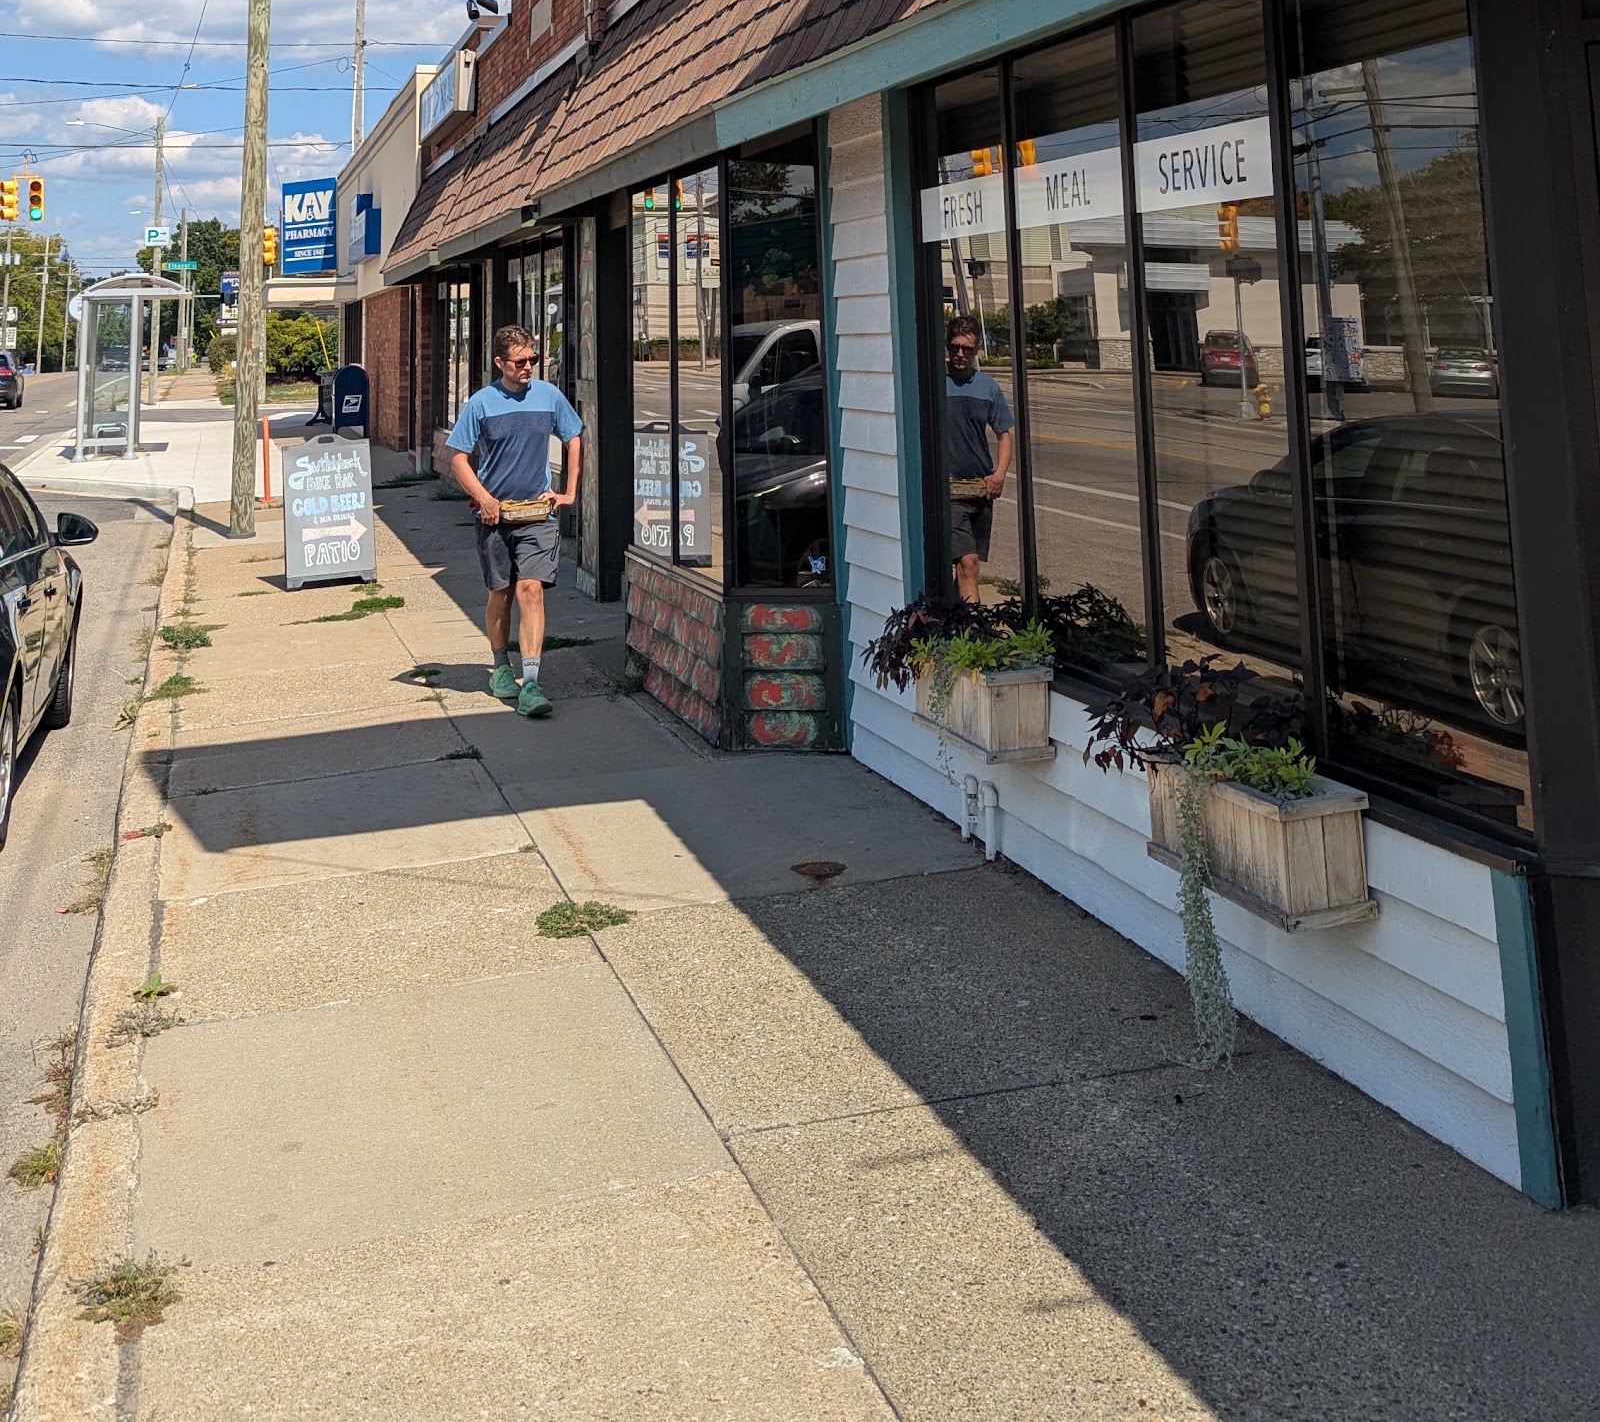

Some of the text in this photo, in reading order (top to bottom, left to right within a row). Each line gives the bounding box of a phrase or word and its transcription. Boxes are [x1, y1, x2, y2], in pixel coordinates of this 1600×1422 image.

[942, 138, 1248, 231] FRESH MEAL SERVICE
[284, 190, 335, 224] KAY
[284, 227, 335, 241] PHARMACY
[294, 249, 313, 258] SINCE
[306, 472, 357, 491] BIKE BAR
[292, 492, 366, 517] COLD BEER!
[304, 540, 360, 567] PATIO
